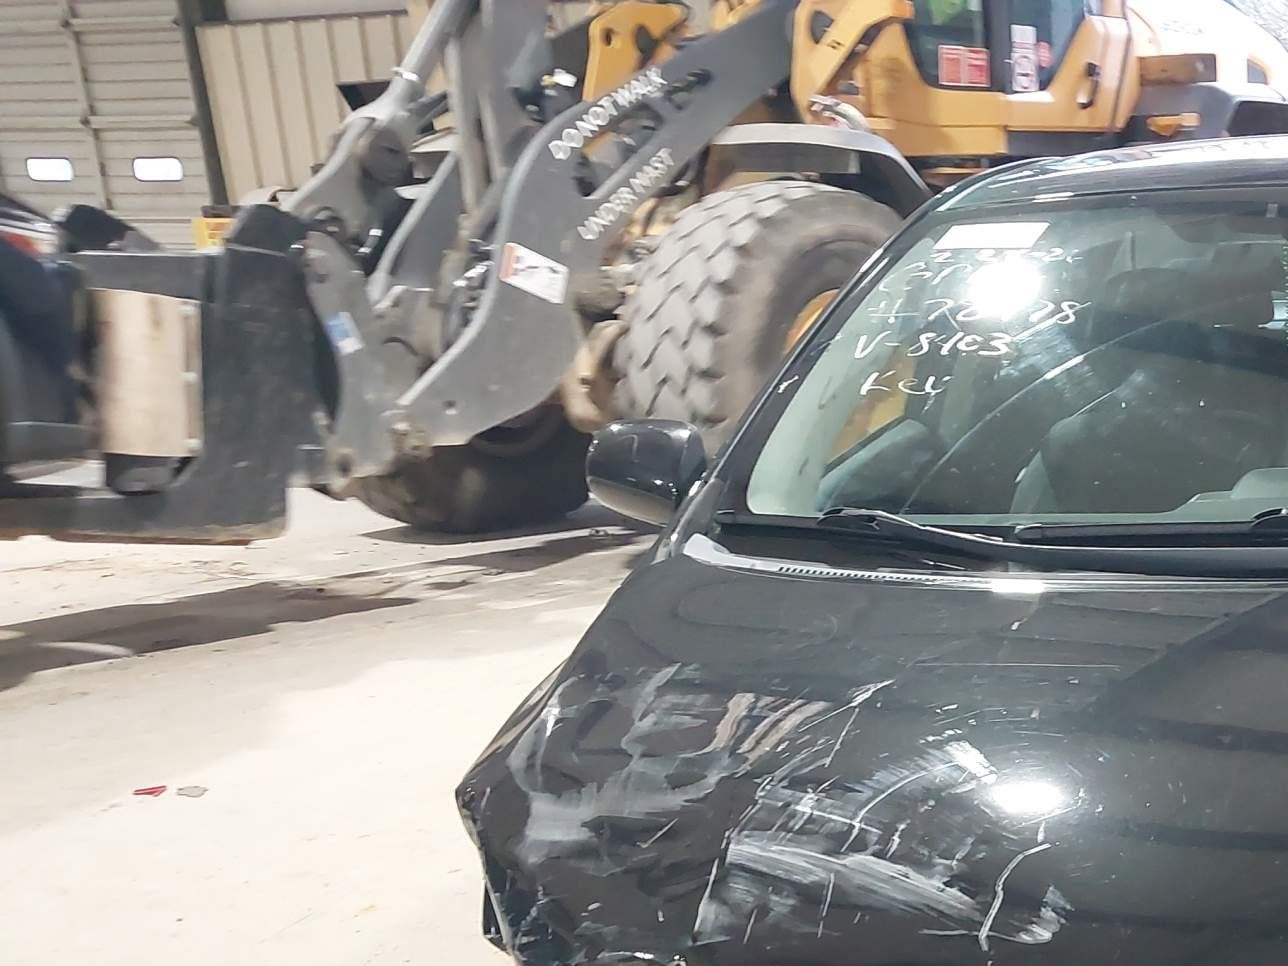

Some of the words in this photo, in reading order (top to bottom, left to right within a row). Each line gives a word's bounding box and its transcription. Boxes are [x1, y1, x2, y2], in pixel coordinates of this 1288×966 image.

[548, 128, 584, 161] DO
[575, 95, 618, 138] NOT
[577, 187, 638, 240] UNDER
